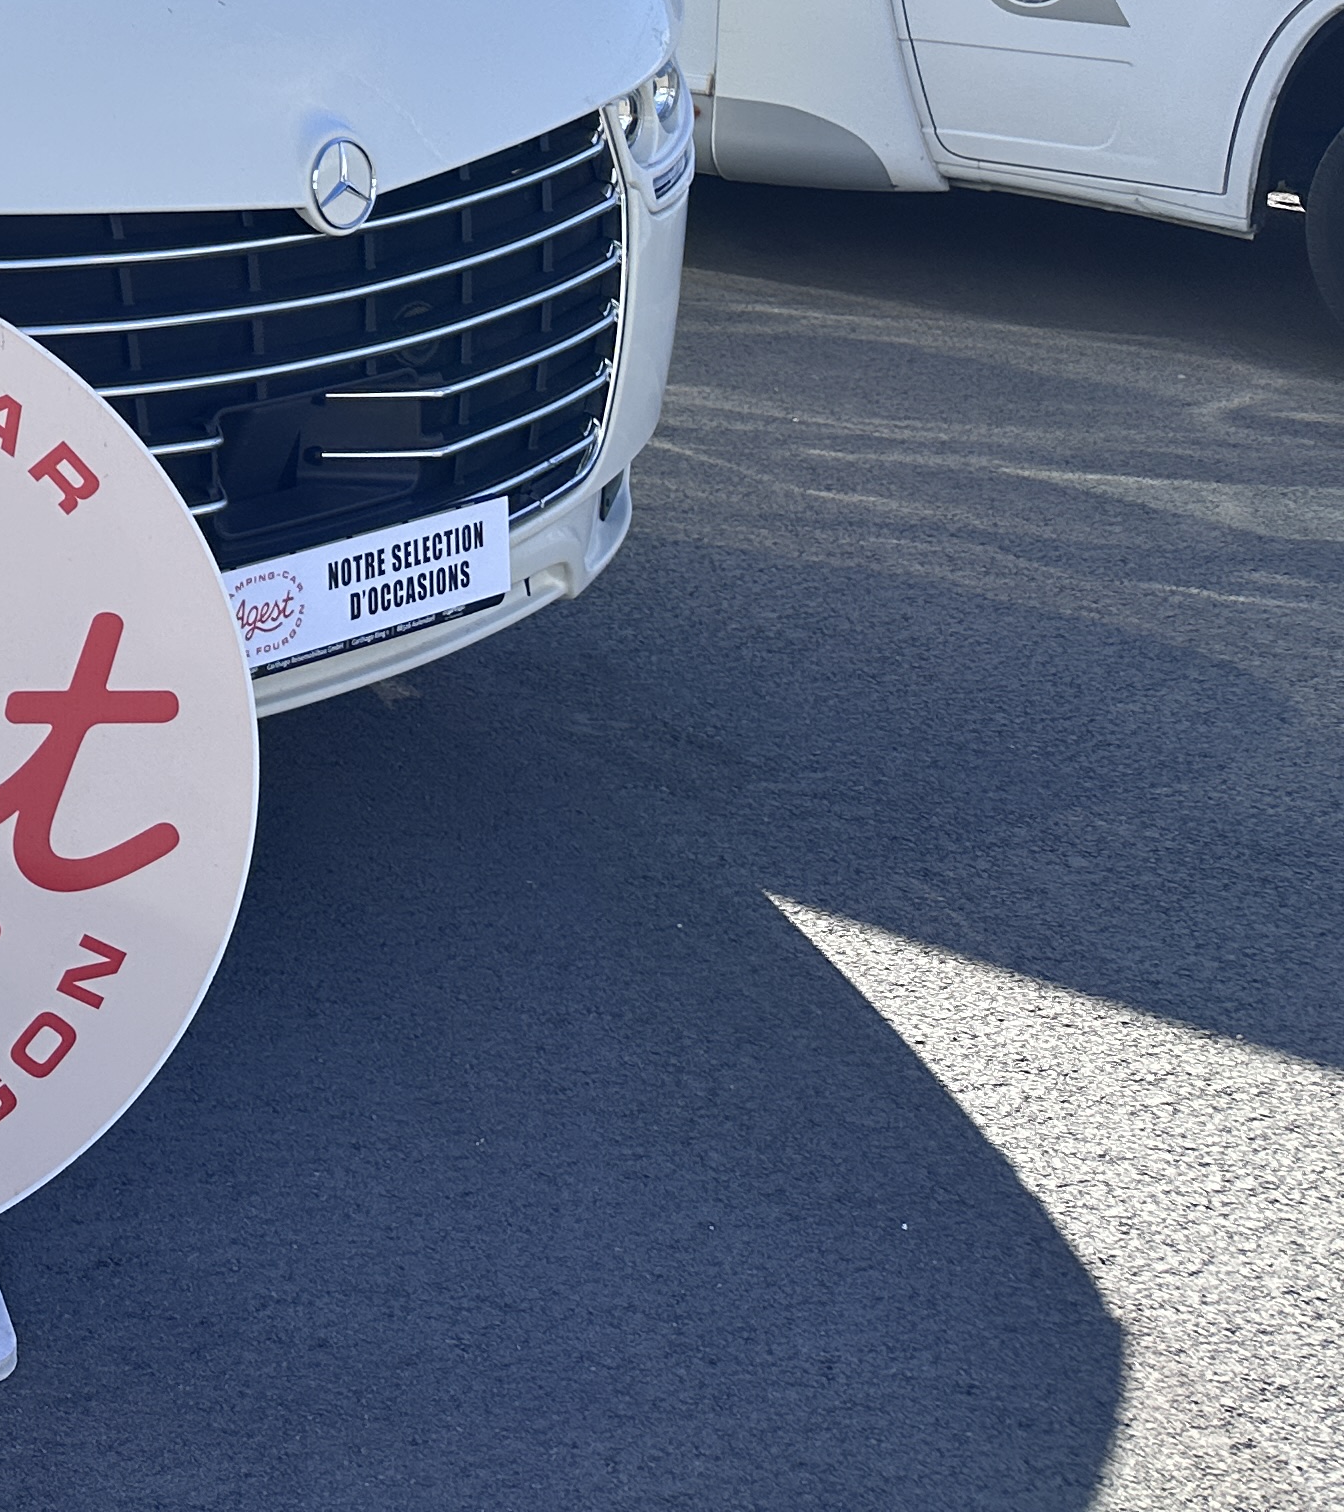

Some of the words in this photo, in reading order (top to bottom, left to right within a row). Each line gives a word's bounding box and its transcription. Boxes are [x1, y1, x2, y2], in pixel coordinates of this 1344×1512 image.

[328, 548, 386, 590] NOTRE
[391, 521, 484, 572] SELECTION
[228, 570, 304, 600] AMPING-CAR
[350, 561, 471, 621] D'OCCASIONS
[255, 603, 306, 656] FOURGON
